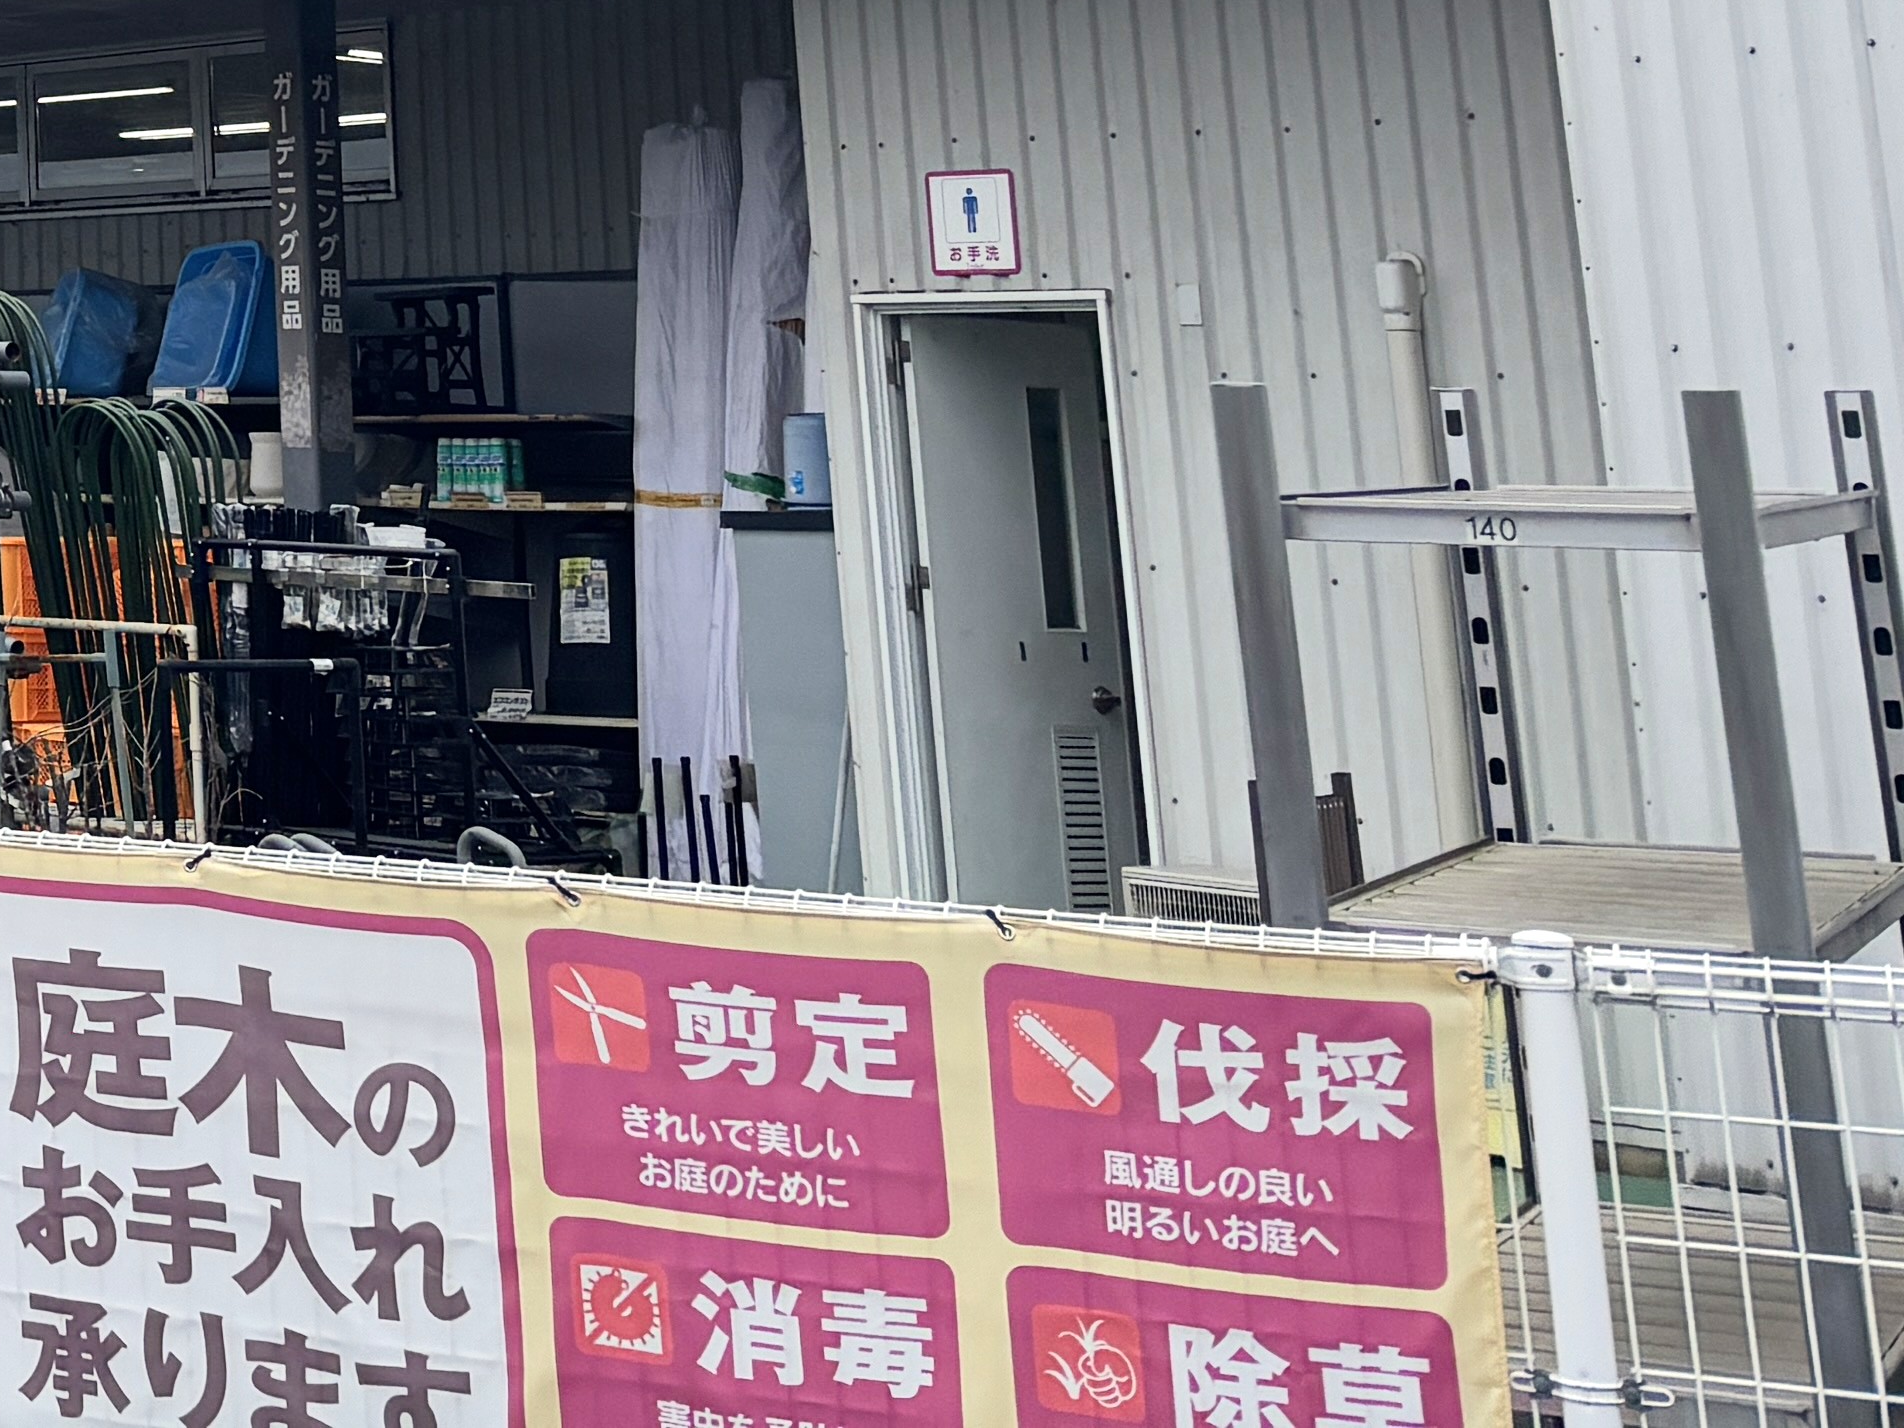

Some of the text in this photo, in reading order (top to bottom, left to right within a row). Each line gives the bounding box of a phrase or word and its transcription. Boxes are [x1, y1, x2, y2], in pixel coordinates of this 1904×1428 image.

[273, 72, 303, 330] ガーデニング用品
[312, 74, 343, 334] ガーデニング用品
[949, 245, 1000, 262] お手洗
[1464, 516, 1517, 542] 140
[9, 948, 457, 1168] 庭木の
[668, 980, 916, 1099] 剪定
[1139, 1018, 1414, 1141] 伐採
[621, 1103, 861, 1161] きれいで美しい
[638, 1151, 850, 1208] お庭のために
[1103, 1149, 1334, 1207] 風通しの良い
[16, 1144, 471, 1321] お手入れ
[1104, 1199, 1340, 1257] 明るいお庭へ
[18, 1292, 471, 1428] 承ります
[690, 1271, 935, 1399] 消毒
[1167, 1322, 1431, 1428] 除草
